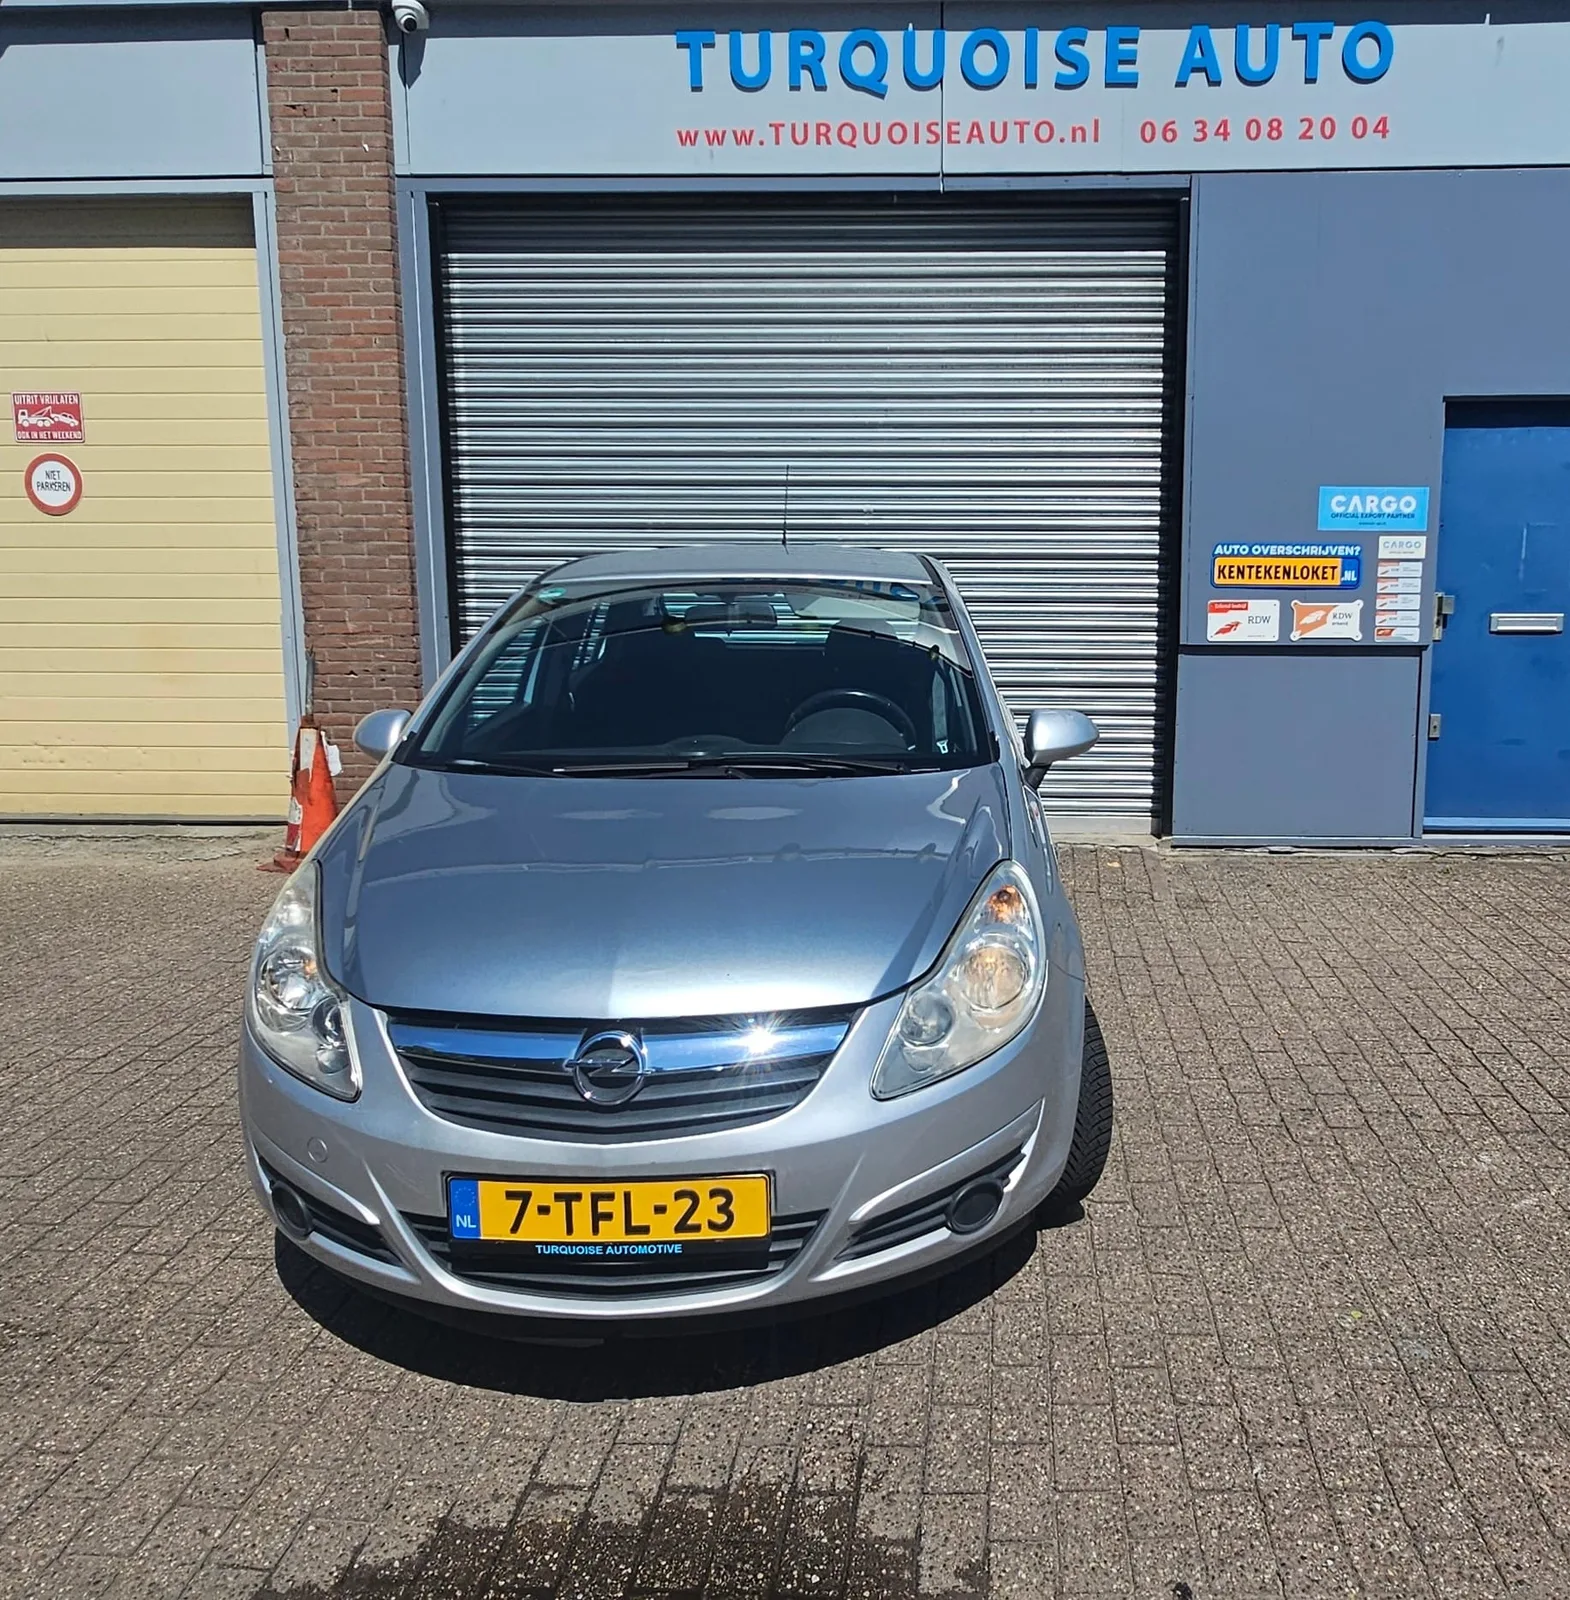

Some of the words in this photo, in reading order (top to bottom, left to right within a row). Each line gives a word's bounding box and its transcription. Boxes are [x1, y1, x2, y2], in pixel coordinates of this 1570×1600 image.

[675, 25, 1141, 100] TURQUOISE
[1174, 20, 1395, 88] AUTO
[677, 118, 1100, 149] www.TURQUOISEAUTO.nl
[1140, 119, 1178, 144] 06
[1193, 118, 1231, 143] 34
[1245, 117, 1283, 142] 08
[1298, 116, 1337, 141] 20
[1351, 115, 1390, 140] 04
[14, 394, 38, 405] UITRIT
[40, 394, 79, 405] VRIJLATEN
[17, 430, 30, 440] OOK
[39, 430, 51, 440] HET
[52, 430, 82, 440] WEEKEND
[45, 470, 61, 481] NIET
[36, 481, 71, 492] PARKEREN
[1330, 494, 1417, 514] CARGO
[1214, 544, 1249, 556] AUTO
[1252, 544, 1361, 556] OVERSCHRIJVEN?
[1382, 541, 1422, 549] CARGO
[1247, 615, 1271, 625] RDW
[455, 1214, 477, 1229] NL
[504, 1187, 736, 1237] 7-TFL-23
[535, 1243, 603, 1255] TURQUOISE
[605, 1243, 683, 1255] AUTOMOTIVE
